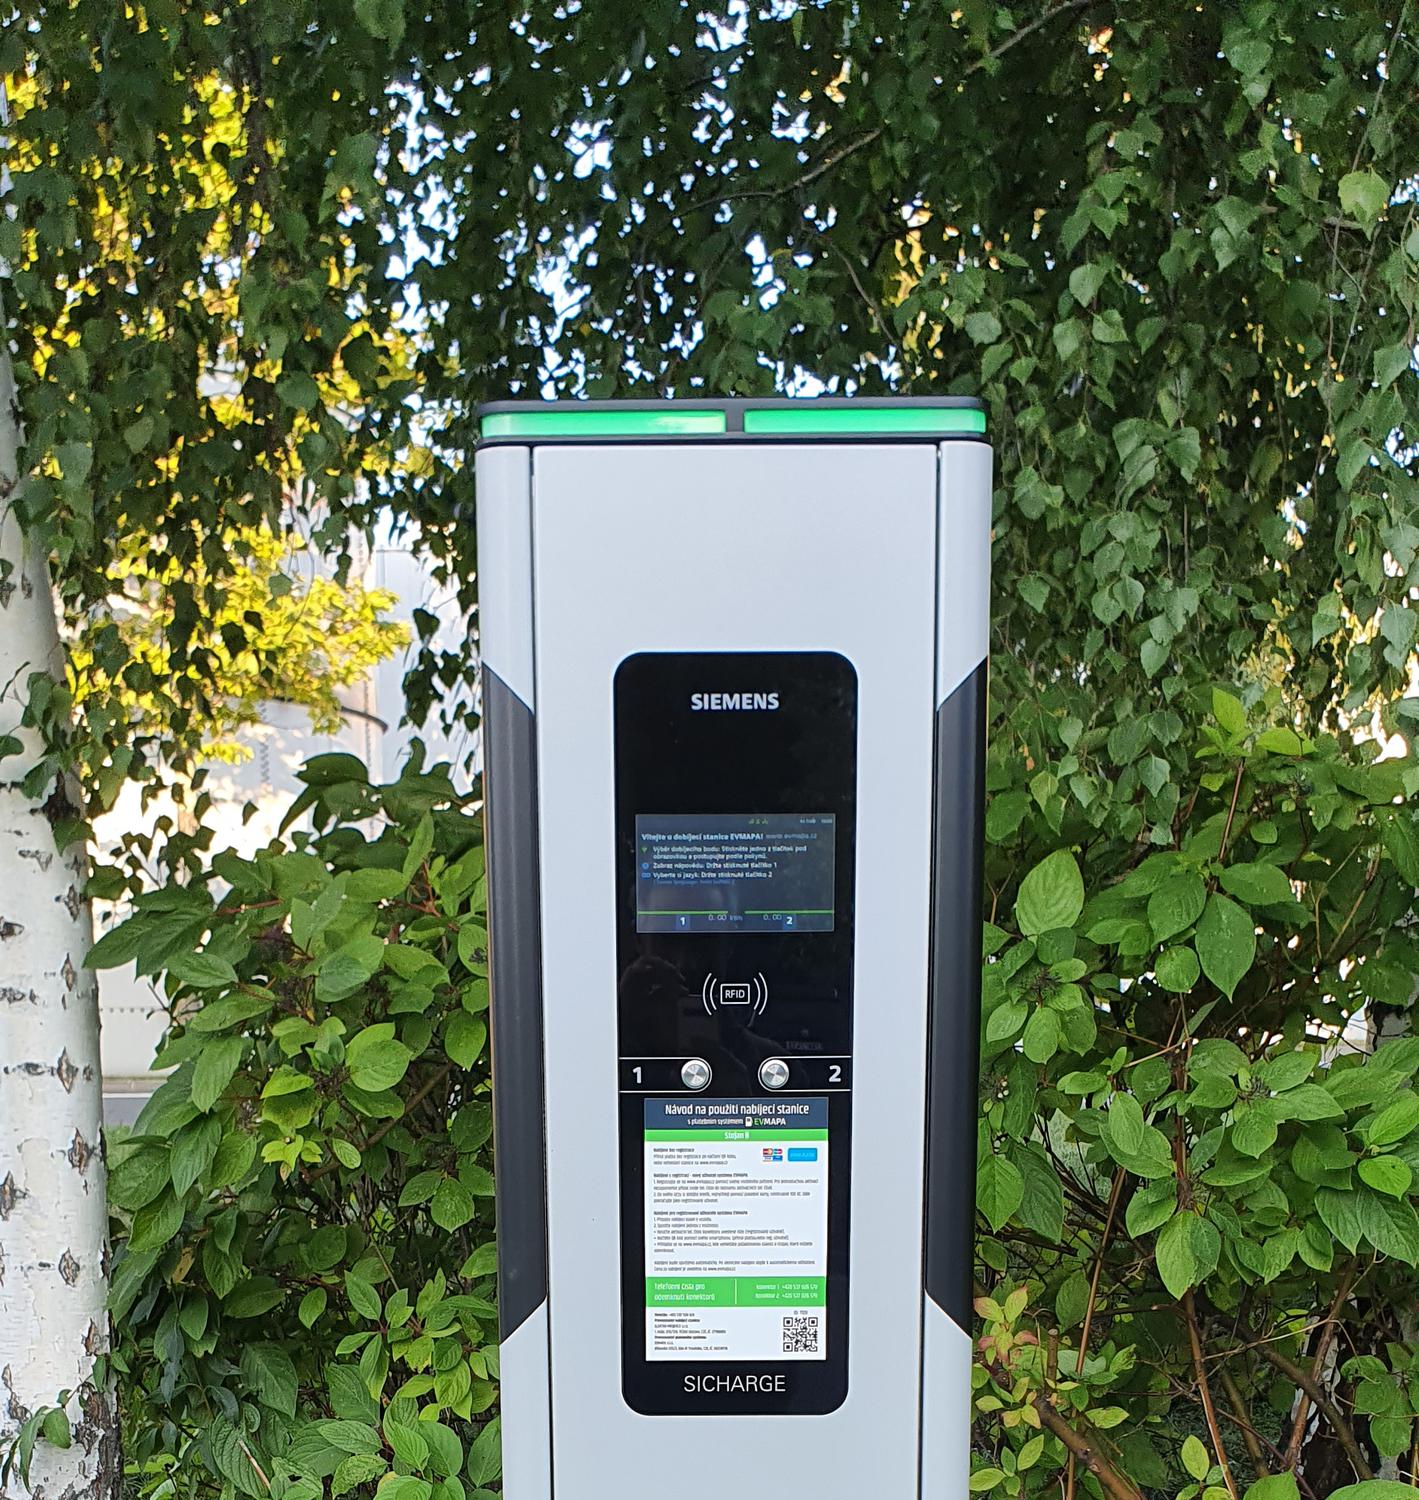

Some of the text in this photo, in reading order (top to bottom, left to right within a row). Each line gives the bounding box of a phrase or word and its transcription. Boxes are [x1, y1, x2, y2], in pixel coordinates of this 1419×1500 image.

[691, 693, 779, 710] SIEMENS
[680, 917, 685, 925] 1
[786, 916, 793, 925] 2
[725, 989, 745, 999] RFID
[632, 1066, 642, 1084] 1
[828, 1065, 842, 1083] 2
[665, 1104, 693, 1115] Návod
[695, 1106, 706, 1115] na
[777, 1103, 810, 1115] stanice
[754, 1117, 787, 1126] EVMAPA
[684, 1375, 786, 1393] SICHARGE
